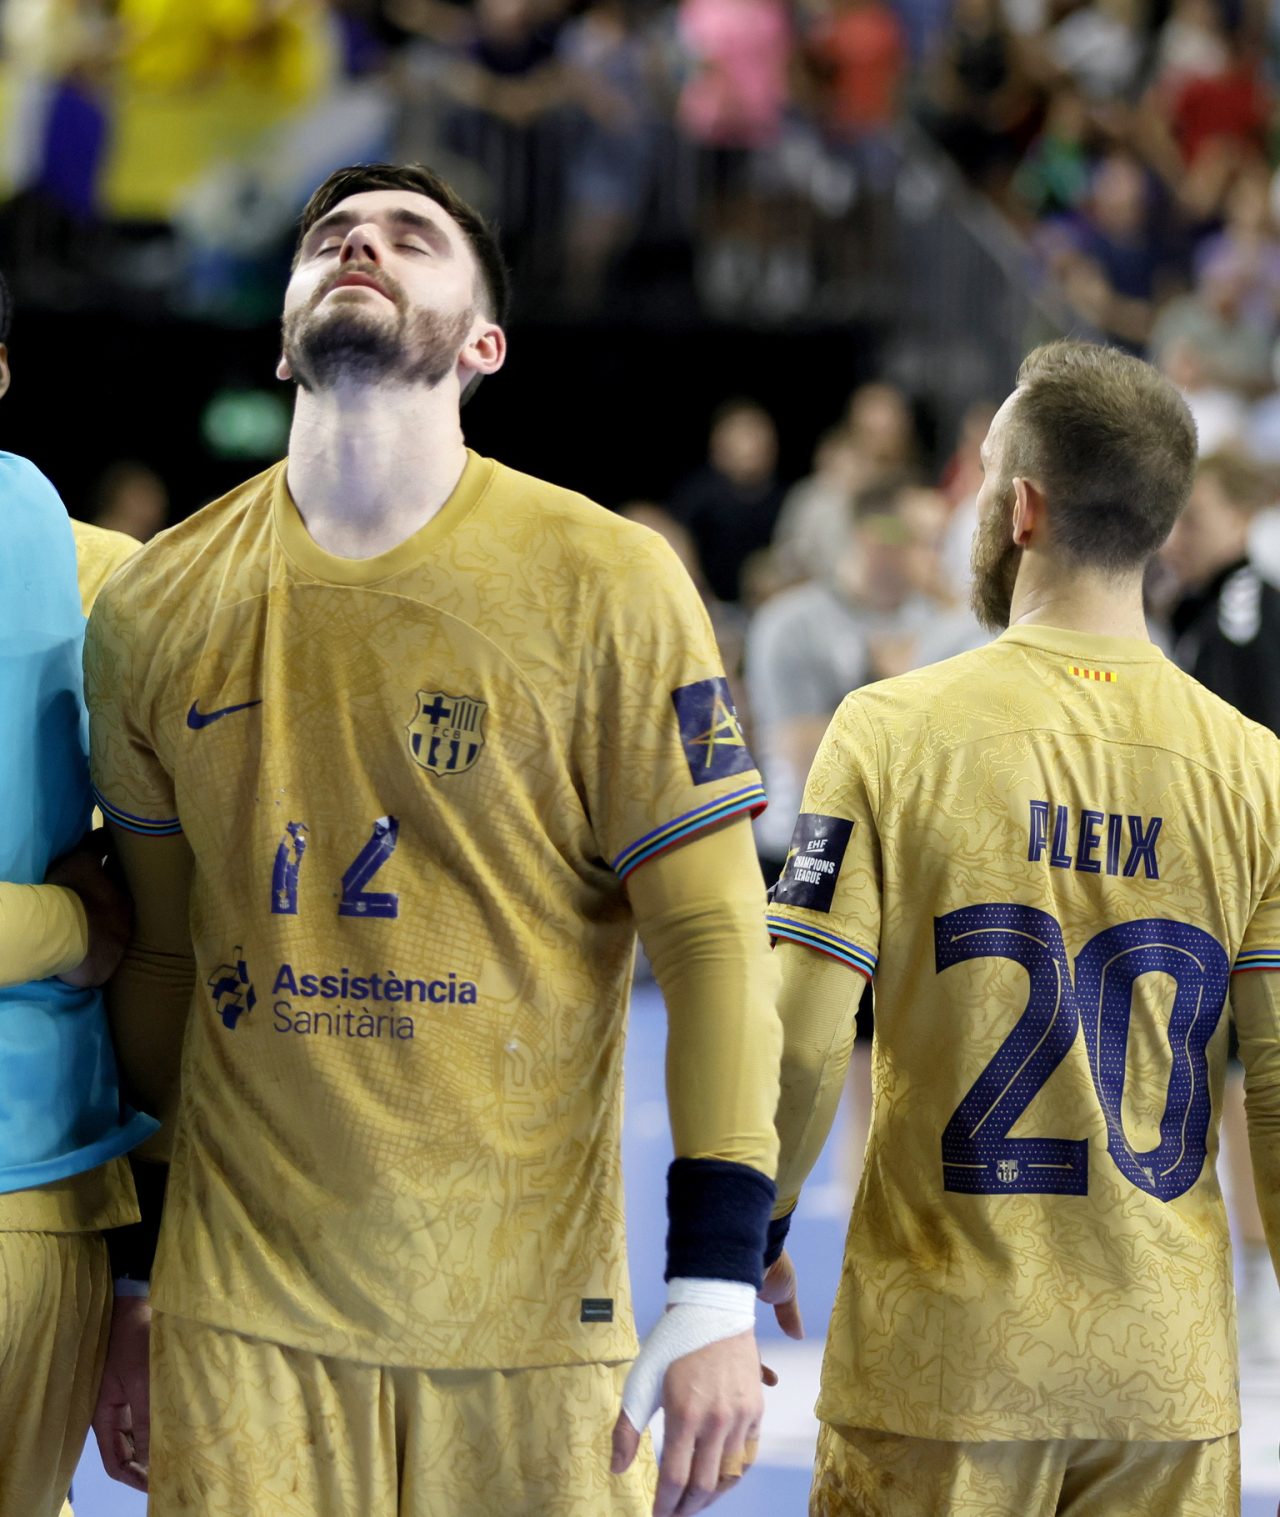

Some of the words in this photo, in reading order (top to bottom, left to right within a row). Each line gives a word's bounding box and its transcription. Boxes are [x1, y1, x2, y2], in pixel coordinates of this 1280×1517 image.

[432, 726, 461, 739] FCB
[806, 839, 829, 852] EHF
[793, 855, 836, 875] CHAMPIONS
[794, 868, 822, 885] LEAGUE
[272, 963, 478, 1005] Assistència
[272, 1000, 415, 1041] Sanitària
[934, 902, 1230, 1202] 20
